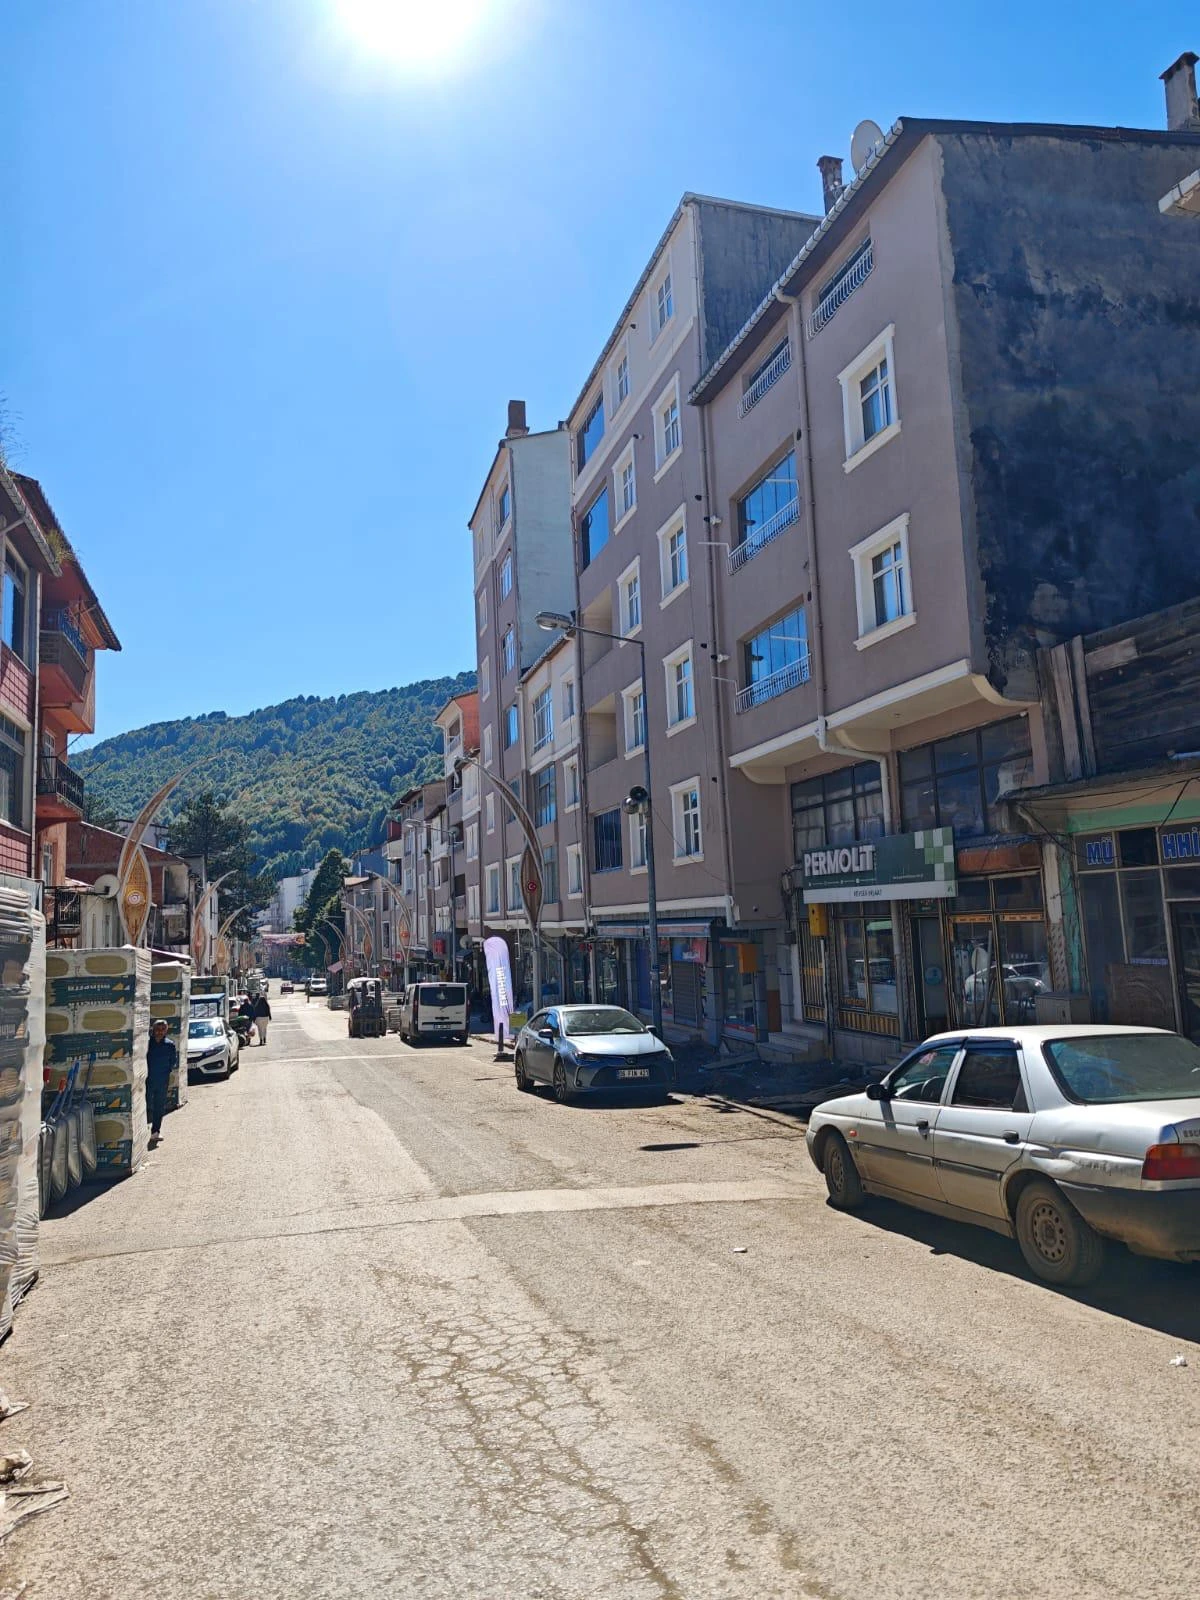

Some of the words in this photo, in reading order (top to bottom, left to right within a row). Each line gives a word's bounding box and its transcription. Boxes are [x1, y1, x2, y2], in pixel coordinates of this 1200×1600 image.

[1086, 836, 1114, 865] MÜ
[1161, 827, 1200, 859] HHİ
[1183, 1129, 1200, 1138] ESC
